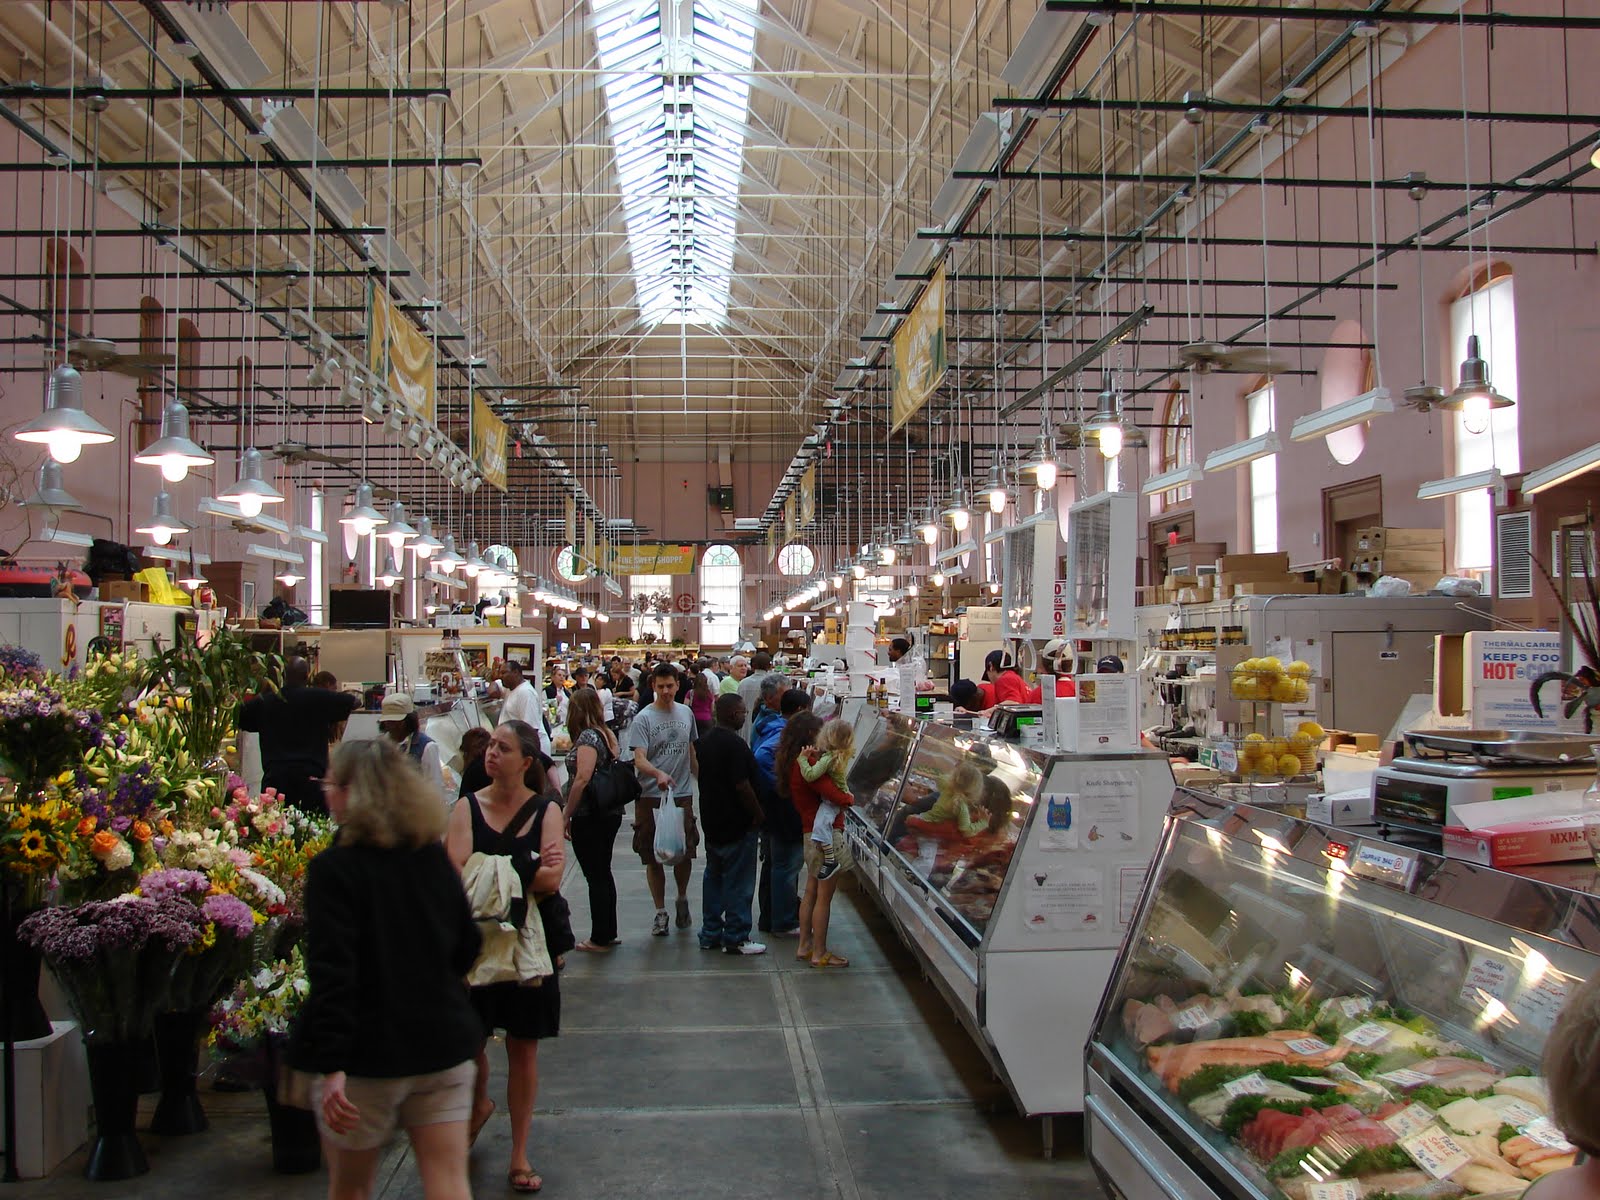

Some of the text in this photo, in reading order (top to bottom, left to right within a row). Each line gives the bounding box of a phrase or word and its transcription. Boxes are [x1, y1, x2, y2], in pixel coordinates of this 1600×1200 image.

[657, 555, 683, 564] SHOPPE
[1483, 653, 1560, 662] KEEPS FOO
[1483, 662, 1517, 680] HOT
[1428, 1137, 1455, 1157] SABLE
[1440, 1135, 1462, 1153] FRESH
